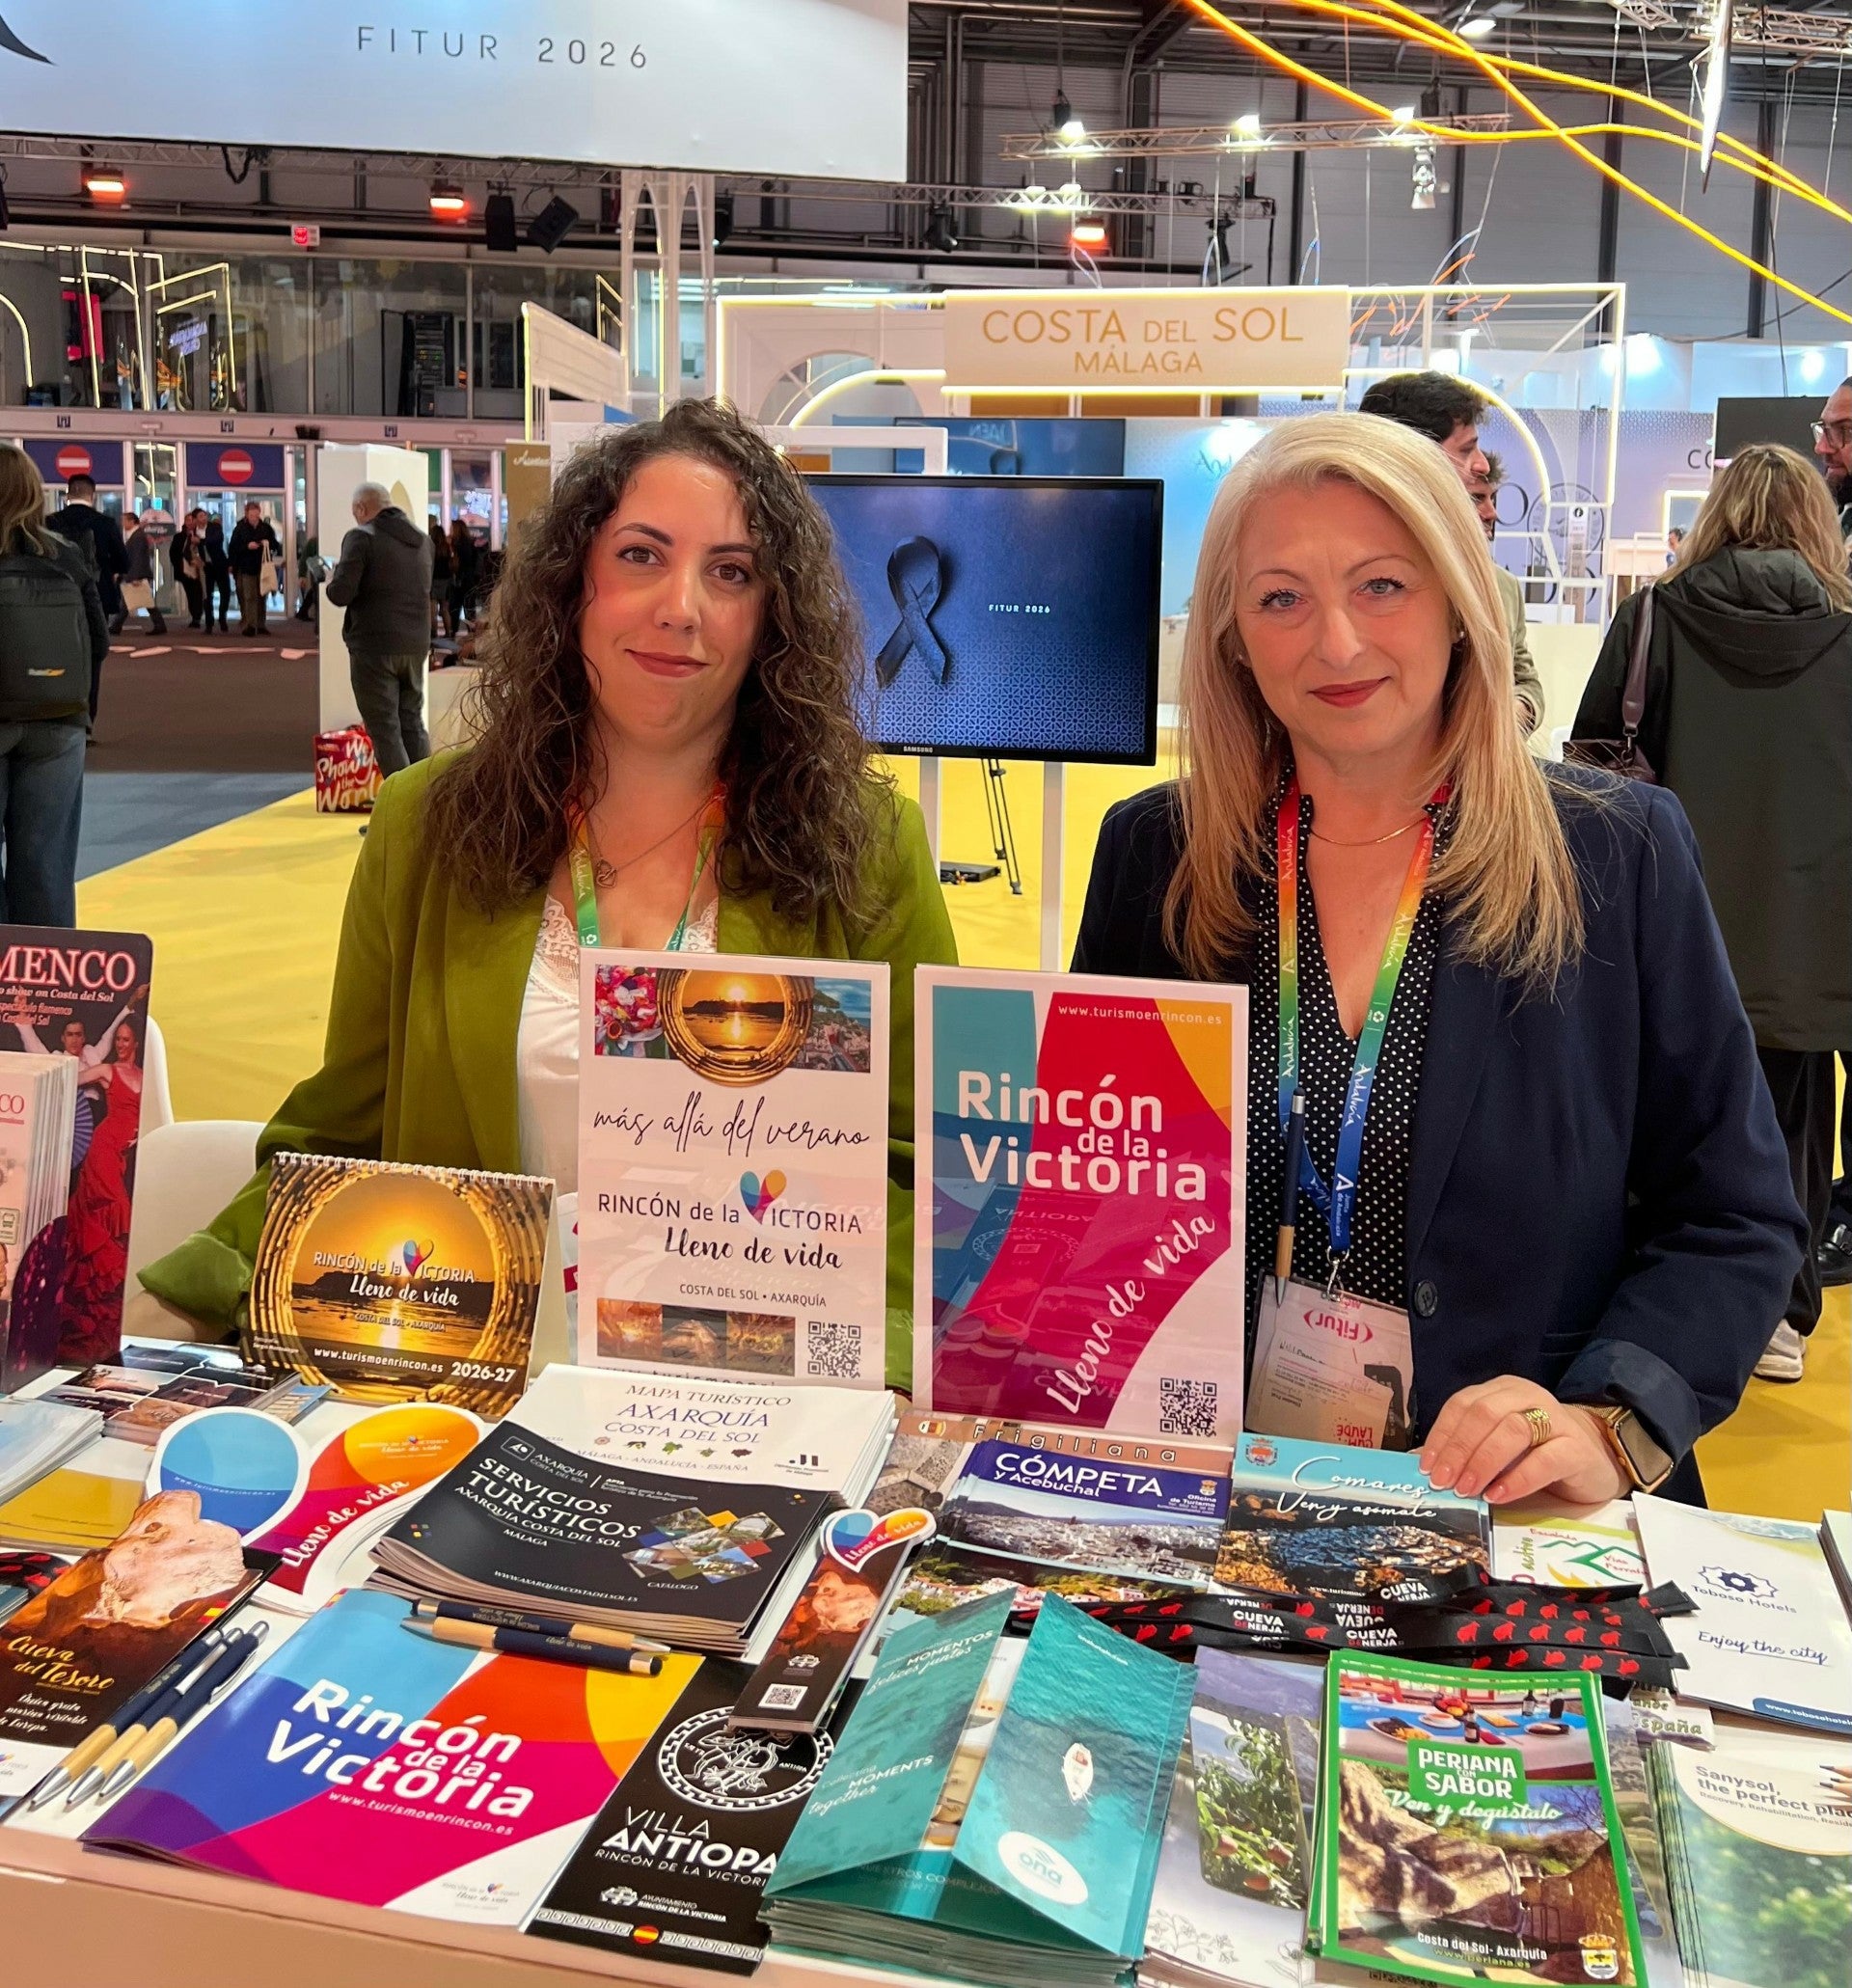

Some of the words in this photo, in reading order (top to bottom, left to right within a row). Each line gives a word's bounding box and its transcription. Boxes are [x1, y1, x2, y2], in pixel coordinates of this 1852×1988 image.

[357, 26, 500, 60] FITUR
[537, 38, 647, 68] 2026
[983, 309, 1127, 343] COSTA
[1143, 320, 1197, 342] DEL
[1213, 307, 1304, 341] SOL
[1075, 344, 1203, 373] MÁLAGA
[988, 604, 1020, 613] FITUR
[1025, 605, 1051, 614] 2026
[1281, 825, 1295, 882] Andalucía
[1382, 912, 1414, 970] Andalucía
[50, 990, 78, 1000] Costa
[80, 991, 95, 1001] del
[96, 992, 114, 1002] Sol
[1058, 1005, 1222, 1024] www.turismoenrincon.es
[958, 1070, 1162, 1133] Rincón
[1344, 1062, 1373, 1128] Andalucía
[593, 1107, 654, 1146] más
[664, 1091, 715, 1152] allá
[722, 1096, 766, 1157] del
[767, 1120, 870, 1150] verano
[1077, 1127, 1114, 1156] de
[1124, 1130, 1150, 1157] la
[960, 1132, 1207, 1202] Victoria
[598, 1192, 681, 1219] RINCÓN
[690, 1202, 713, 1221] de
[723, 1204, 740, 1223] la
[313, 1251, 367, 1272] RINCÓN
[370, 1260, 386, 1274] de
[389, 1261, 401, 1276] la
[665, 1226, 733, 1260] Lleno
[744, 1237, 776, 1265] de
[784, 1242, 843, 1269] vida
[349, 1274, 393, 1298] Lleno
[398, 1282, 419, 1301] de
[423, 1289, 460, 1306] vida
[679, 1284, 714, 1296] COSTA
[717, 1288, 737, 1299] DEL
[739, 1289, 759, 1300] SOL
[771, 1292, 827, 1308] AXARQUÍA
[1046, 1319, 1113, 1414] Lleno
[1104, 1279, 1145, 1318] de
[1143, 1214, 1215, 1275] vida
[1313, 1313, 1360, 1342] Fitur
[313, 1348, 444, 1374] www.turismoenrincon.es
[451, 1362, 517, 1383] 2026-27
[625, 1384, 681, 1400] MAPA
[686, 1389, 792, 1407] TURÍSTICO
[617, 1402, 770, 1428] AXARQUÍA
[604, 1422, 671, 1438] COSTA
[679, 1429, 717, 1443] DEL
[722, 1431, 762, 1444] SOL
[973, 1424, 1176, 1463] Frigiliana
[535, 1453, 588, 1479] AXARQUÍA
[994, 1452, 1162, 1497] CÓMPETA
[1292, 1457, 1431, 1499] Comares
[479, 1457, 613, 1517] SERVICIOS
[994, 1470, 1004, 1482] y
[1005, 1471, 1102, 1497] Acebuchal
[454, 1483, 518, 1525] AXARQUÍA
[521, 1518, 563, 1538] COSTA
[567, 1531, 593, 1543] DEL
[595, 1537, 621, 1548] SOL
[466, 1470, 641, 1540] TURÍSTICOS
[1276, 1491, 1324, 1514] Ven
[1318, 1502, 1348, 1520] y
[282, 1523, 333, 1567] Lleno
[327, 1506, 358, 1525] de
[356, 1479, 410, 1507] vida
[503, 1528, 548, 1547] MÁLAGA
[494, 1569, 639, 1603] WWW.AXARQUIACOSTADELSOL.ES
[646, 1580, 699, 1592] CATÁLOGO
[1380, 1580, 1429, 1600] CUEVA
[1692, 1585, 1746, 1604] Toboso
[1749, 1595, 1797, 1614] Hotels
[1233, 1610, 1284, 1627] CUEVA
[1347, 1627, 1398, 1641] CUEVA
[7, 1635, 75, 1662] Cueva
[907, 1629, 994, 1667] MOMENTOS
[1698, 1630, 1749, 1653] Enjoy
[1752, 1638, 1785, 1655] the
[1789, 1645, 1828, 1665] city
[14, 1660, 43, 1675] del
[42, 1662, 115, 1689] Tesoro
[292, 1678, 522, 1763] Rincón
[266, 1719, 534, 1818] Victoria
[403, 1747, 448, 1772] de
[451, 1754, 487, 1779] la
[848, 1755, 934, 1789] MOMENTS
[1418, 1747, 1517, 1780] PERIANA
[1425, 1771, 1513, 1801] SABOR
[1696, 1765, 1781, 1795] Sanysol,
[1698, 1778, 1729, 1795] the
[1735, 1789, 1810, 1811] perfect
[328, 1791, 514, 1836] www.turismoenrincon.es
[1383, 1787, 1430, 1814] Ven
[1434, 1804, 1454, 1827] y
[1700, 1791, 1747, 1809] Recovery,
[627, 1806, 709, 1839] VILLA
[602, 1828, 777, 1874] ANTIOPA
[594, 1849, 654, 1868] RINCÓN
[658, 1860, 678, 1872] DE
[682, 1864, 700, 1876] LA
[707, 1867, 768, 1888] VICTORI
[1020, 1851, 1063, 1886] ona
[641, 1893, 697, 1910] AYUNTAMIENTO
[691, 1910, 726, 1922] VICTORIA
[1417, 1931, 1449, 1949] Costa
[1451, 1939, 1468, 1952] del
[1433, 1947, 1531, 1969] www.periana.es
